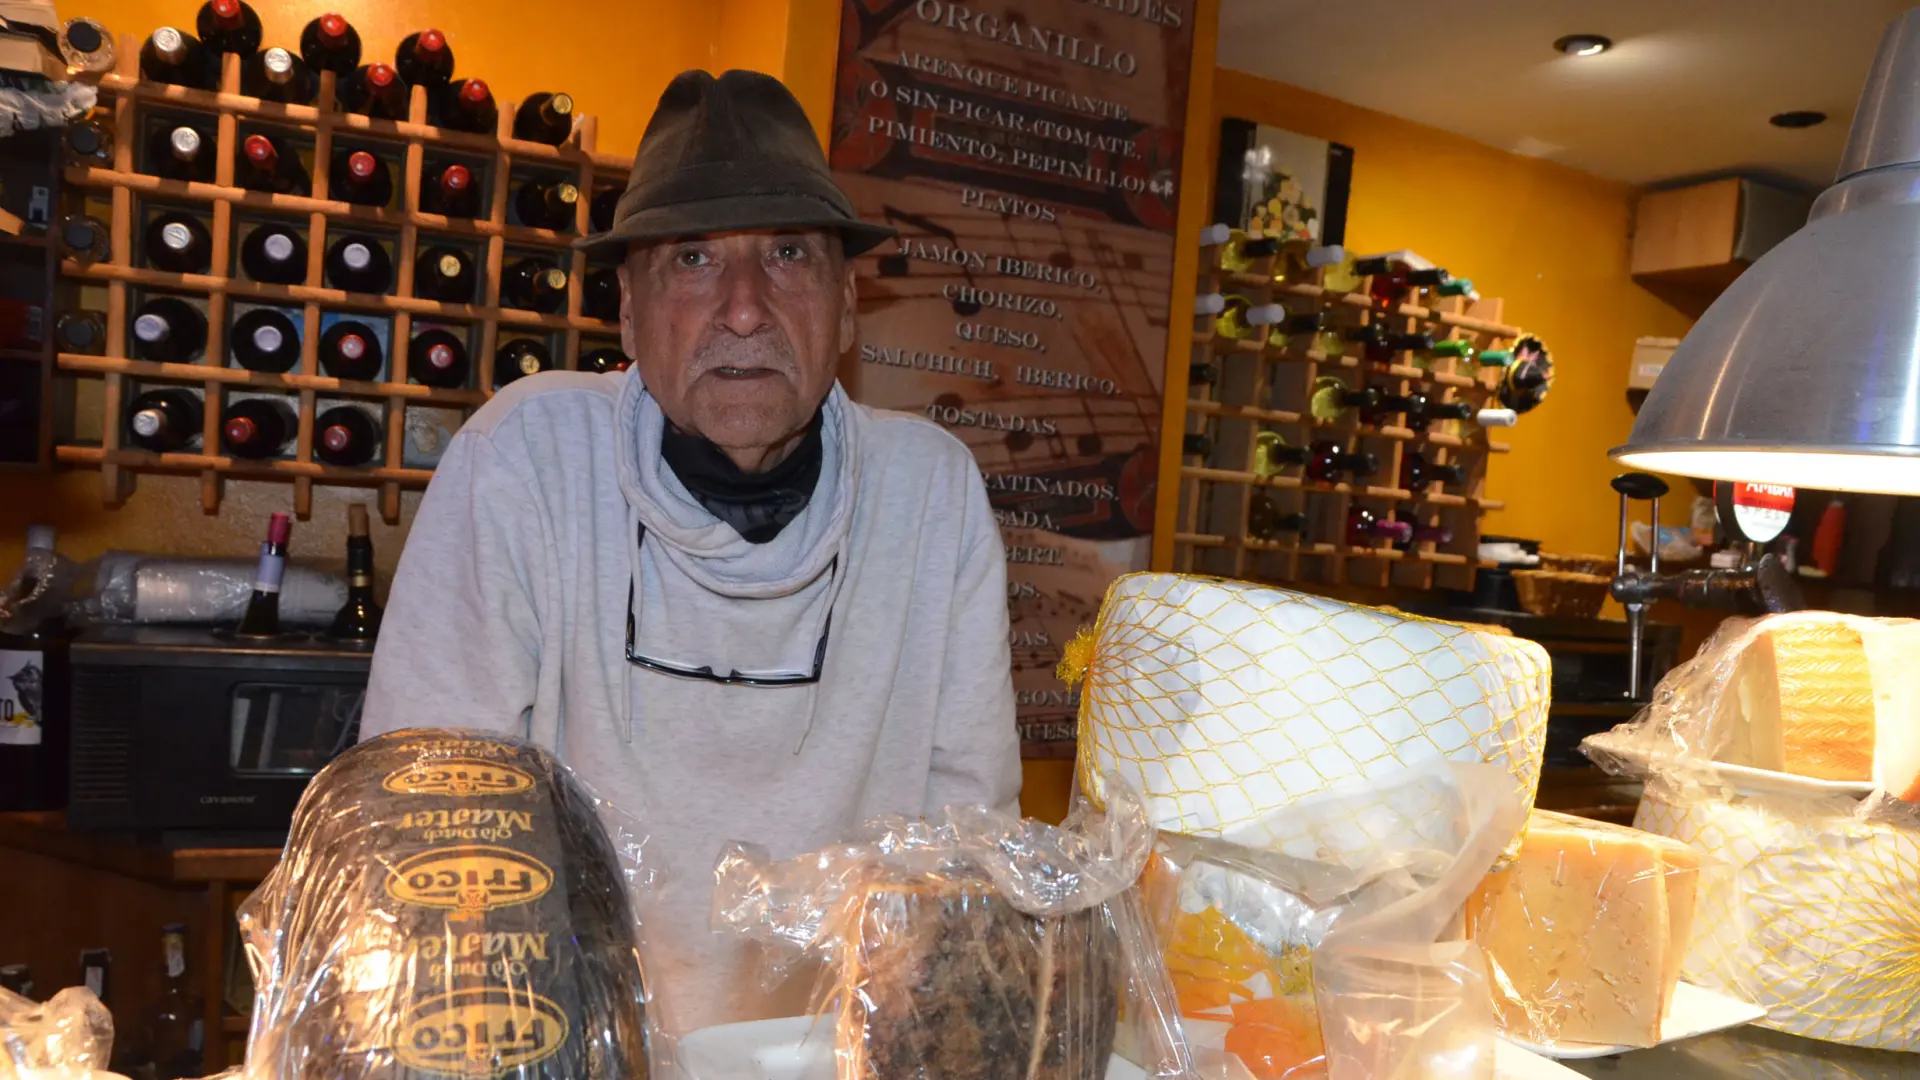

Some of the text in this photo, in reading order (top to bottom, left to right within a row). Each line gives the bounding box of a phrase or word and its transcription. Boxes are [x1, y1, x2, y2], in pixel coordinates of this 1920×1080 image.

[916, 0, 1137, 76] ORGANILLO
[870, 80, 888, 98] O
[896, 86, 940, 110] SIN
[896, 50, 1129, 121] ARENQUE PICANTE
[962, 188, 1056, 220] PLATOS
[897, 238, 987, 269] JAMON
[926, 403, 1057, 435] TOSTADAS
[403, 771, 517, 787] Frico
[395, 808, 533, 832] Master
[408, 869, 532, 893] Frico
[413, 1018, 545, 1055] Frico
